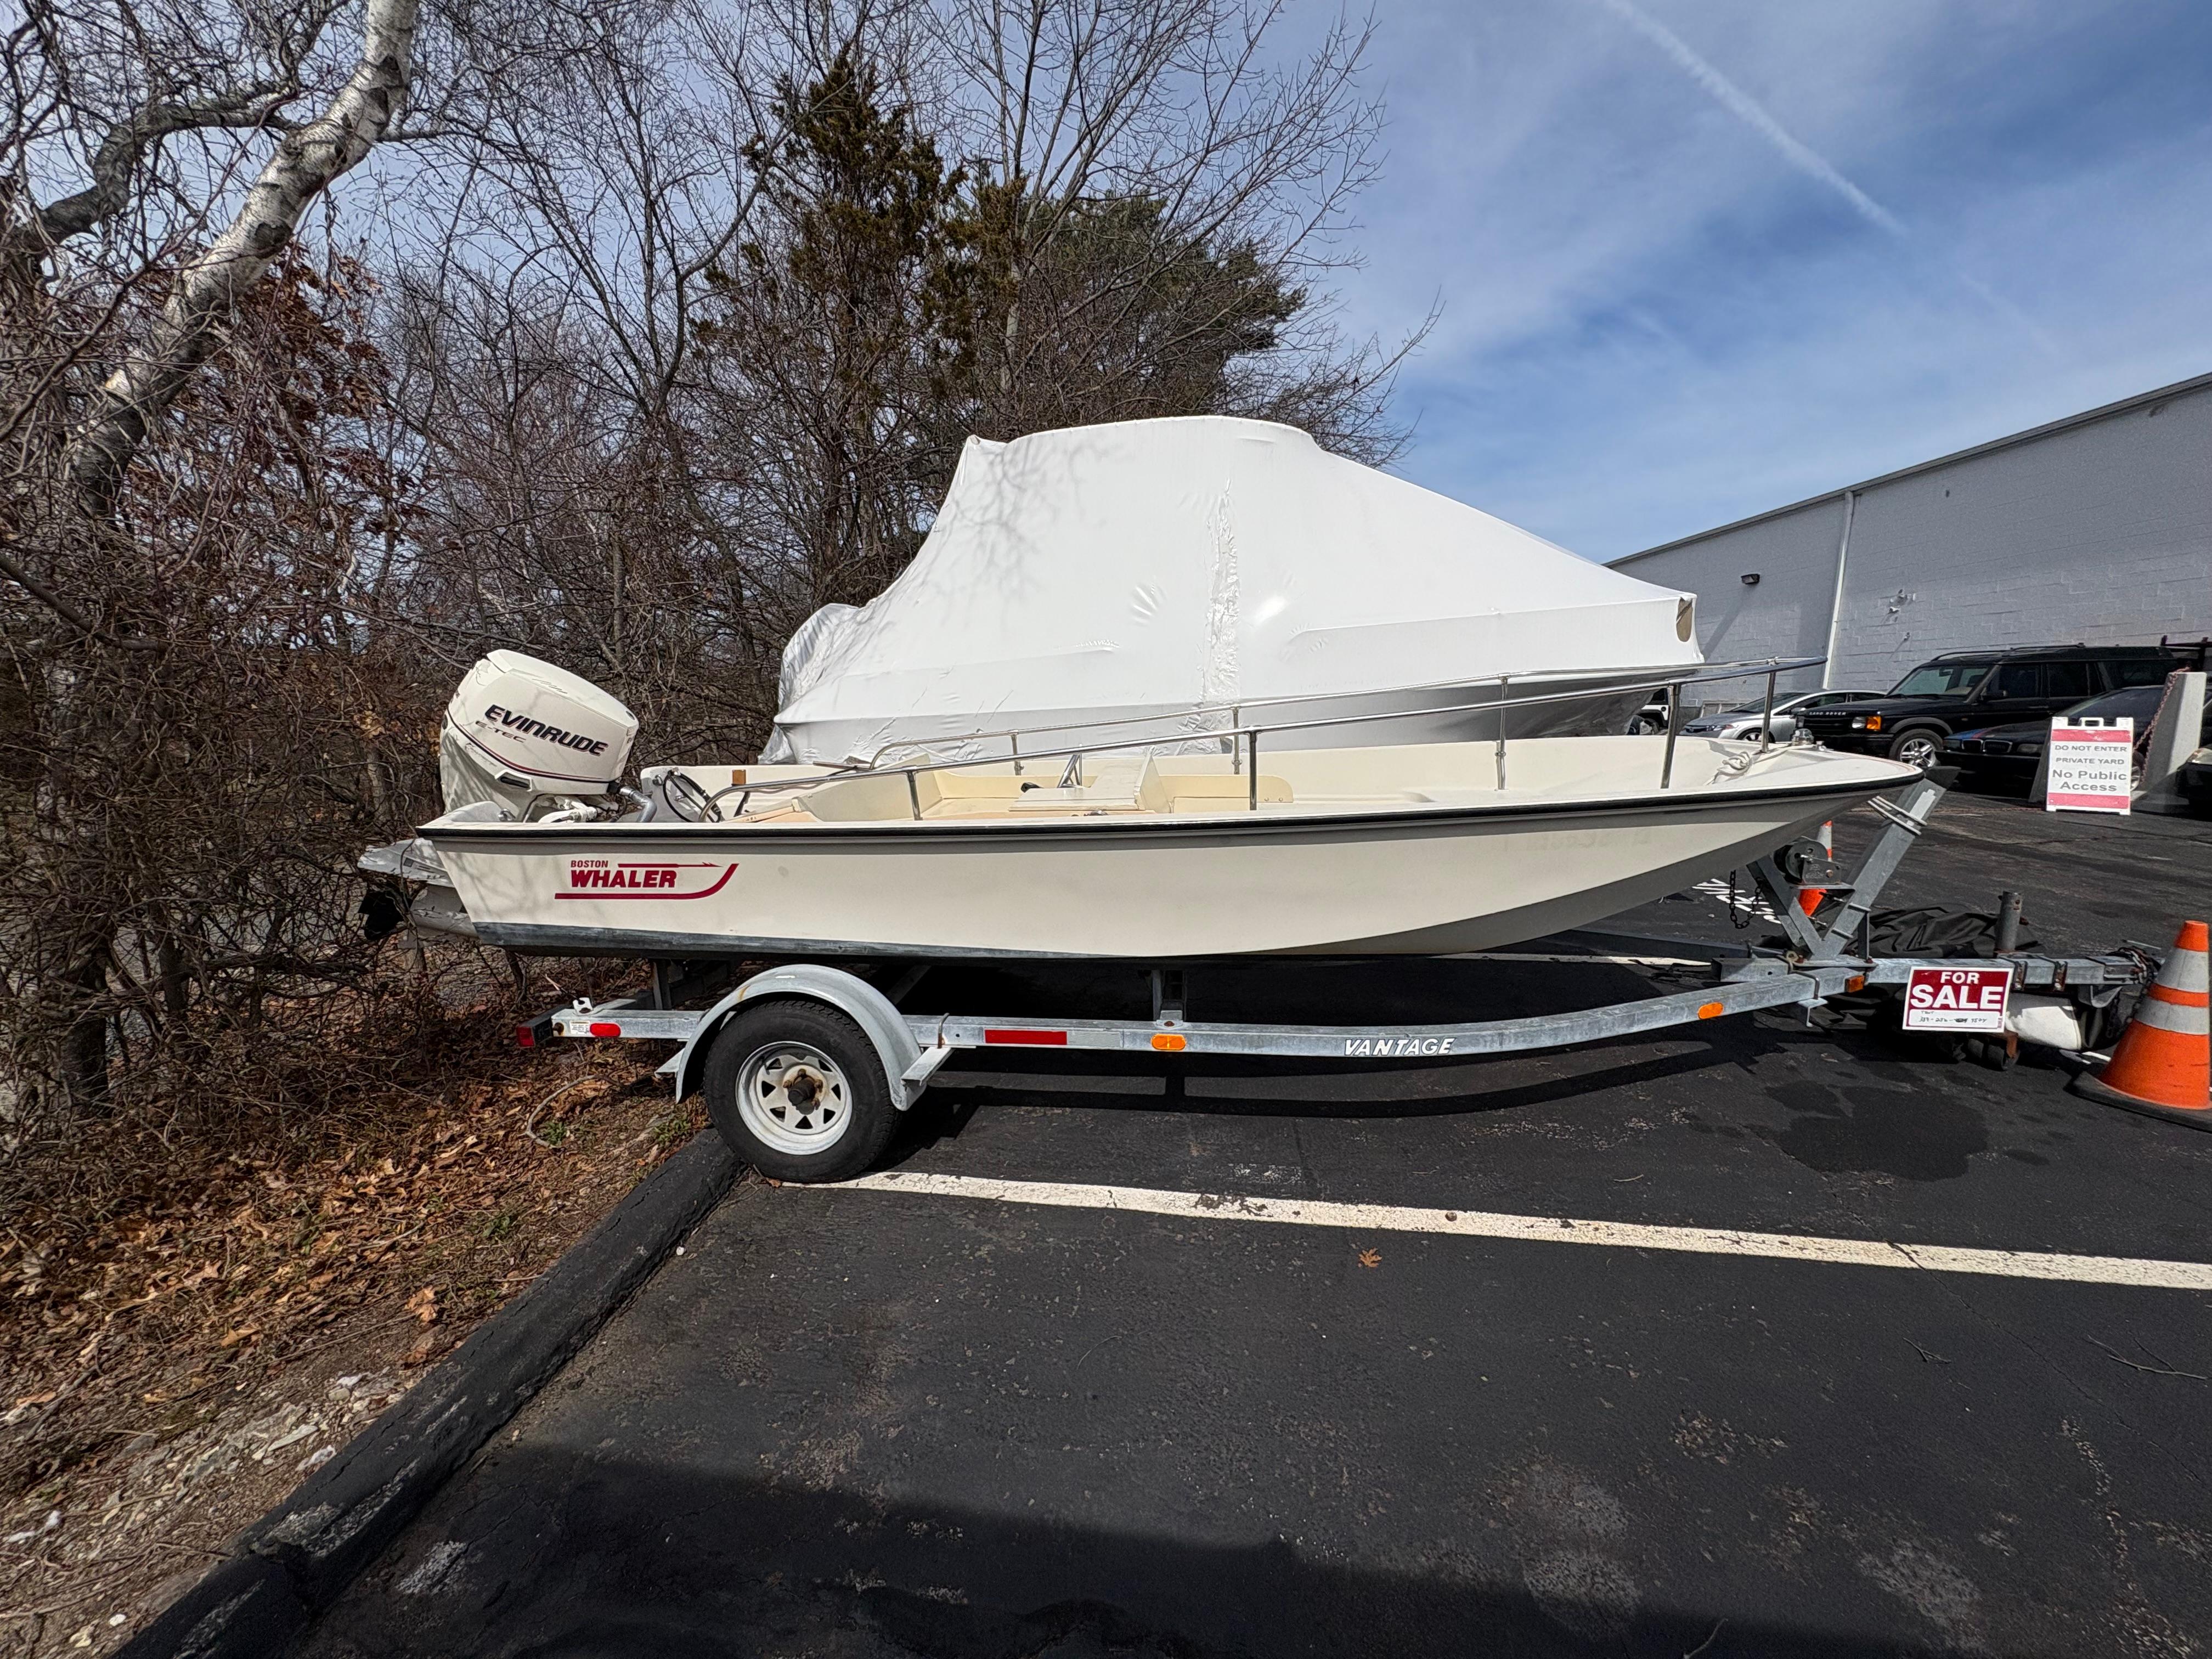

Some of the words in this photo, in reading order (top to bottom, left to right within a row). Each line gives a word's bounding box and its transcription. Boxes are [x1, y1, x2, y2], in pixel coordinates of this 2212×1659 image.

[475, 720, 527, 743] E-TEC
[484, 704, 608, 757] EVINRUDE
[2052, 769, 2073, 778] No
[2078, 770, 2127, 780] Public
[2059, 781, 2117, 792] Access
[571, 870, 677, 888] WHALER
[1940, 972, 1980, 984] FOR
[1910, 984, 2004, 1009] SALE
[1344, 1037, 1457, 1056] VANTAGE
